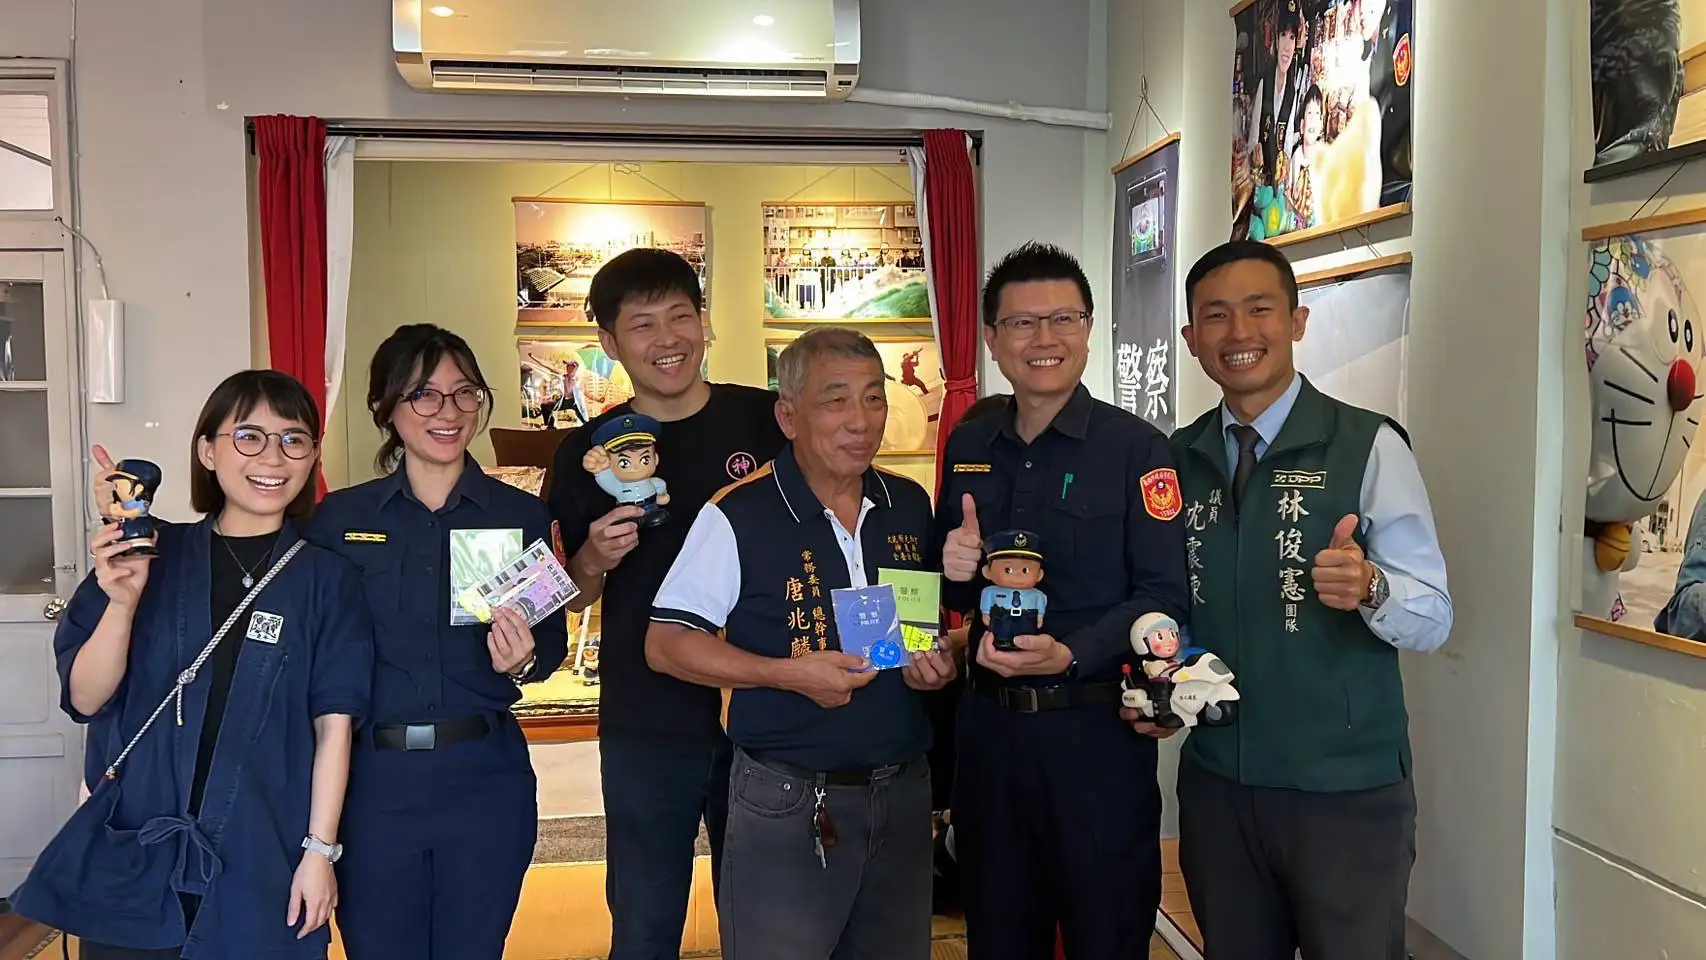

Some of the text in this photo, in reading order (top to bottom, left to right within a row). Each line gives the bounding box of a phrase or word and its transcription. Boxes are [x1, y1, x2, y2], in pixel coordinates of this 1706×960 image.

[1117, 338, 1169, 420] 警察
[731, 455, 750, 475] 神
[1288, 474, 1322, 484] DPP
[1208, 488, 1222, 523] 議員
